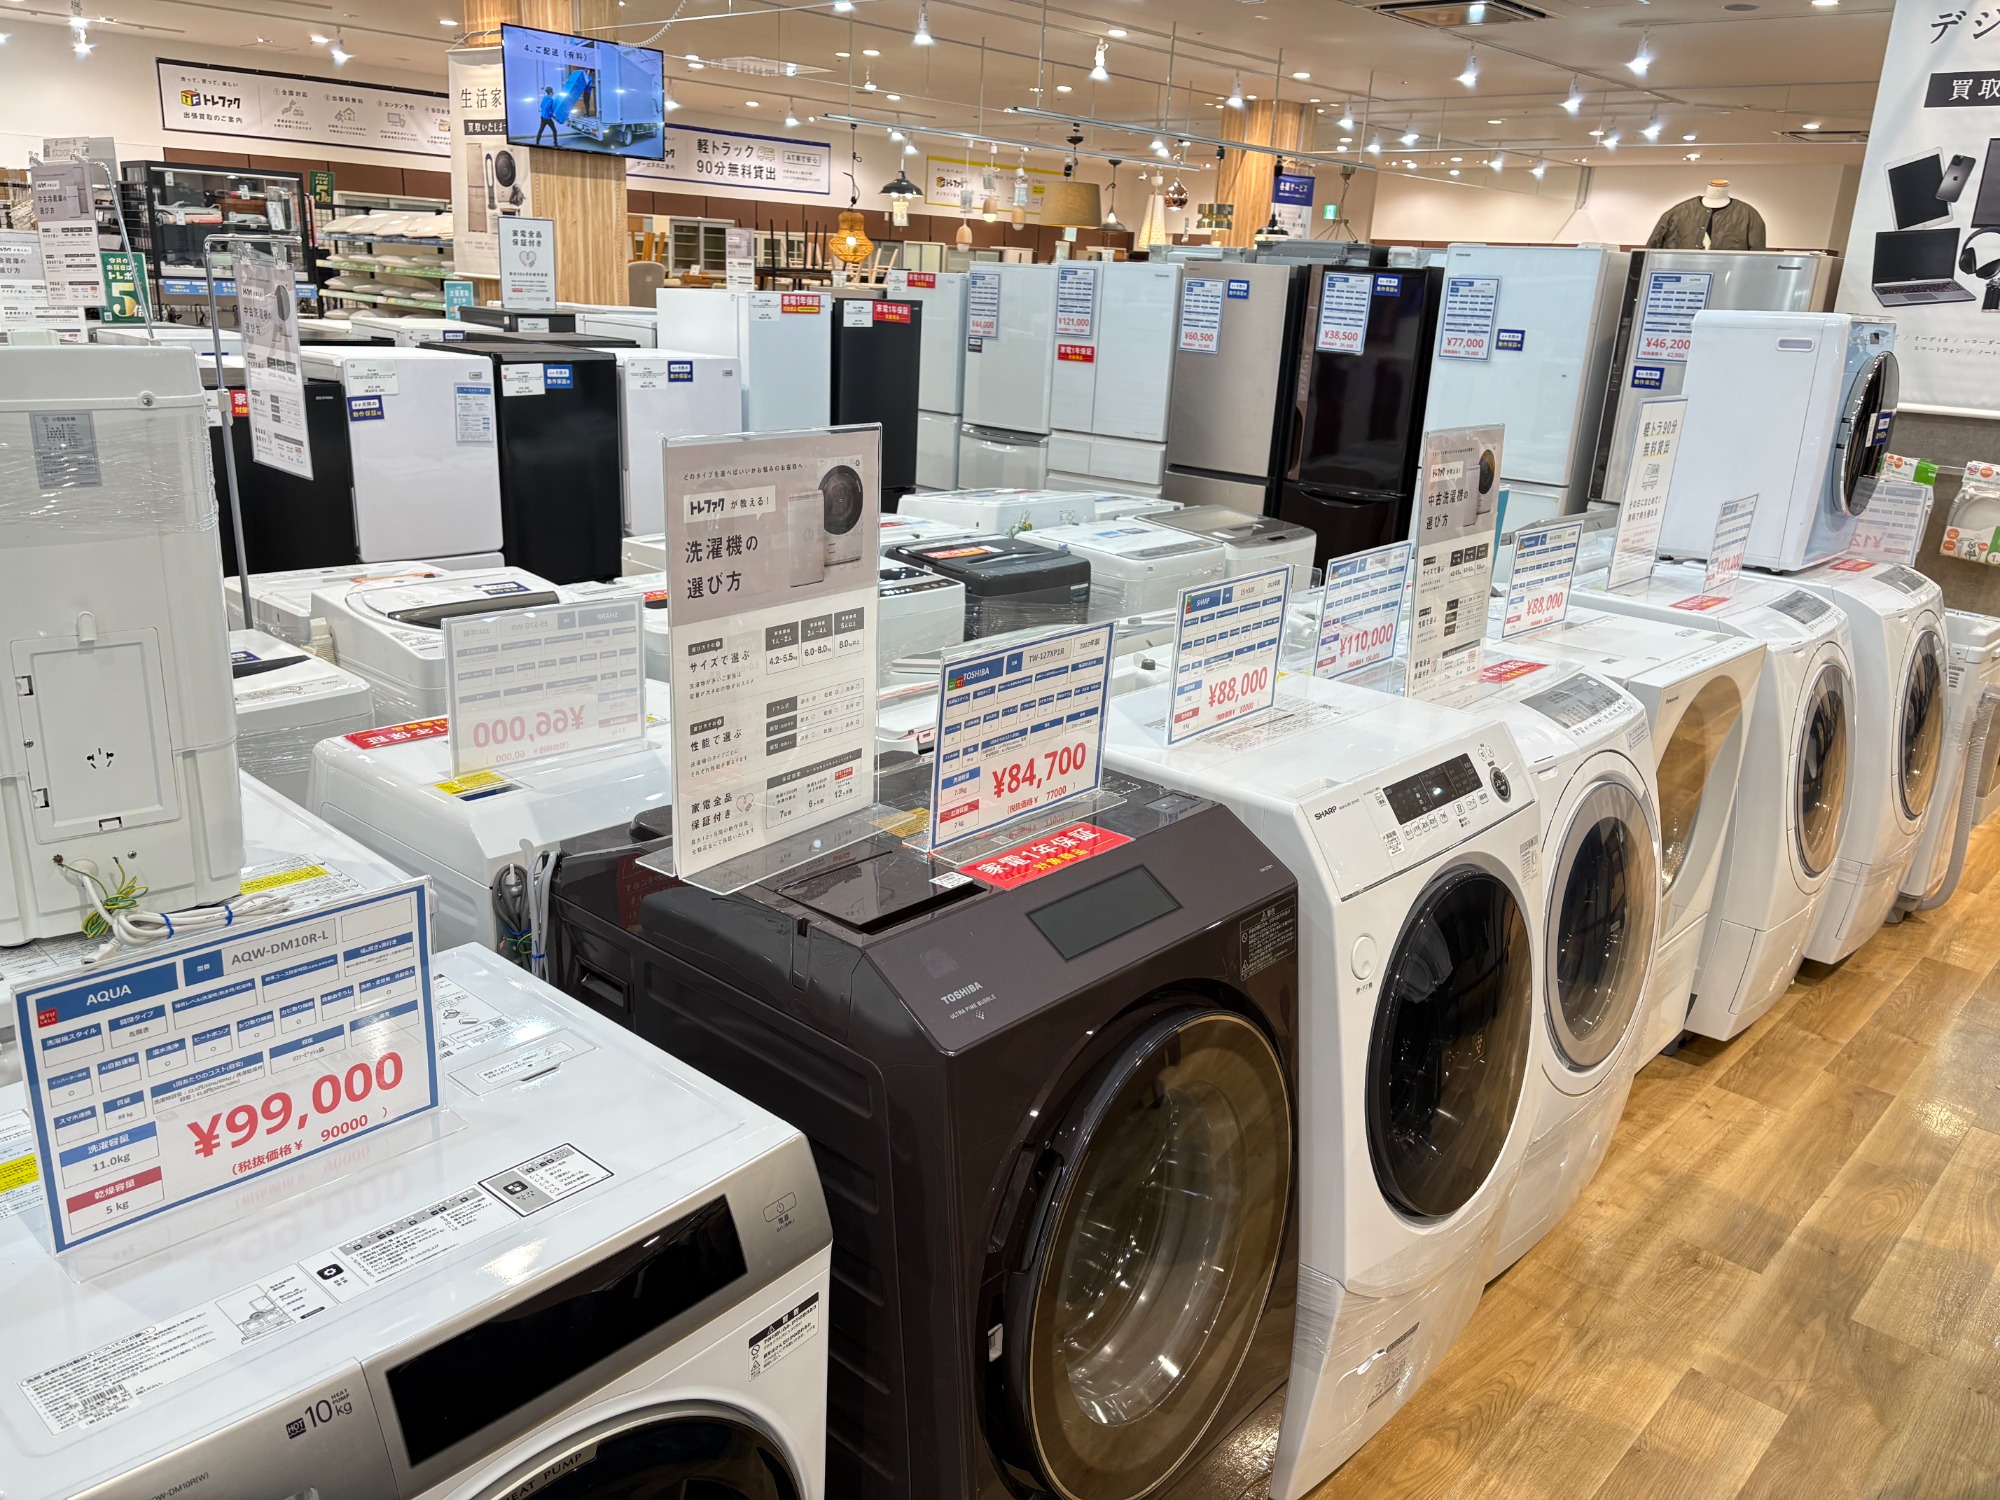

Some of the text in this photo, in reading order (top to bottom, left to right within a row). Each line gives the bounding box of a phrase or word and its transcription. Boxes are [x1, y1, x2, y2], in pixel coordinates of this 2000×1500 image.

[203, 94, 241, 110] トレファク
[183, 111, 243, 125] 出張買取のご案内
[696, 138, 754, 159] 軽トラック
[696, 159, 776, 181] 90分無料貸出
[512, 229, 543, 239] 家電全品
[512, 239, 543, 248] 保証付き
[112, 282, 138, 319] 5
[1058, 317, 1090, 327] ¥121,000
[1184, 331, 1214, 342] ¥60,500
[1324, 329, 1358, 342] ¥38,500
[1446, 337, 1484, 349] ¥77,000
[1646, 337, 1691, 351] ¥46,200
[1667, 351, 1685, 359] 42,000
[1643, 419, 1678, 438] 軽トラ90分
[1642, 439, 1671, 457] 無料貸出
[690, 498, 725, 516] トレファク
[1426, 513, 1449, 531] 選び方
[685, 534, 759, 564] 洗濯機の
[687, 570, 743, 600] 選び方
[1196, 597, 1211, 607] SHARP
[1526, 591, 1564, 617] ¥88,000
[1339, 623, 1394, 658] ¥110,000
[690, 650, 751, 673] サイズで選ぶ
[1029, 647, 1065, 663] TW-127XP1R
[963, 667, 990, 681] TOSHIBA
[1208, 666, 1268, 708] ¥88,000
[690, 726, 742, 753] 性能で選ぶ
[992, 742, 1087, 799] ¥84,700
[1046, 786, 1067, 801] 77000
[691, 791, 733, 815] 家電全品
[691, 808, 731, 831] 保証付き
[1314, 805, 1338, 821] SHARP
[976, 827, 1100, 876] 家電1年保証
[1033, 848, 1089, 872] 対象商品
[231, 930, 329, 966] AQW-DM10R-L
[86, 984, 132, 1006] AQUA
[941, 981, 983, 1004] TOSHIBA
[281, 1001, 314, 1016] カビ取り機能
[119, 1010, 154, 1027] 開閉タイプ
[238, 1014, 273, 1030] シワ取り機能
[46, 1027, 97, 1047] 洗濯機スタイル
[194, 1028, 230, 1044] ヒートポンプ
[152, 1043, 180, 1056] 温水洗浄
[186, 1052, 404, 1158] ¥99,000
[60, 1109, 92, 1125] スマホ連携
[320, 1114, 369, 1143] 90000
[87, 1133, 130, 1155] 洗濯容量
[92, 1153, 131, 1173] 11.0kg
[94, 1179, 136, 1201] 乾燥容量
[116, 1200, 130, 1215] kg
[331, 1388, 348, 1400] HEAT
[332, 1393, 350, 1405] PUMP
[305, 1399, 333, 1428] 10
[335, 1401, 353, 1416] kg
[543, 1453, 582, 1481] PUMP
